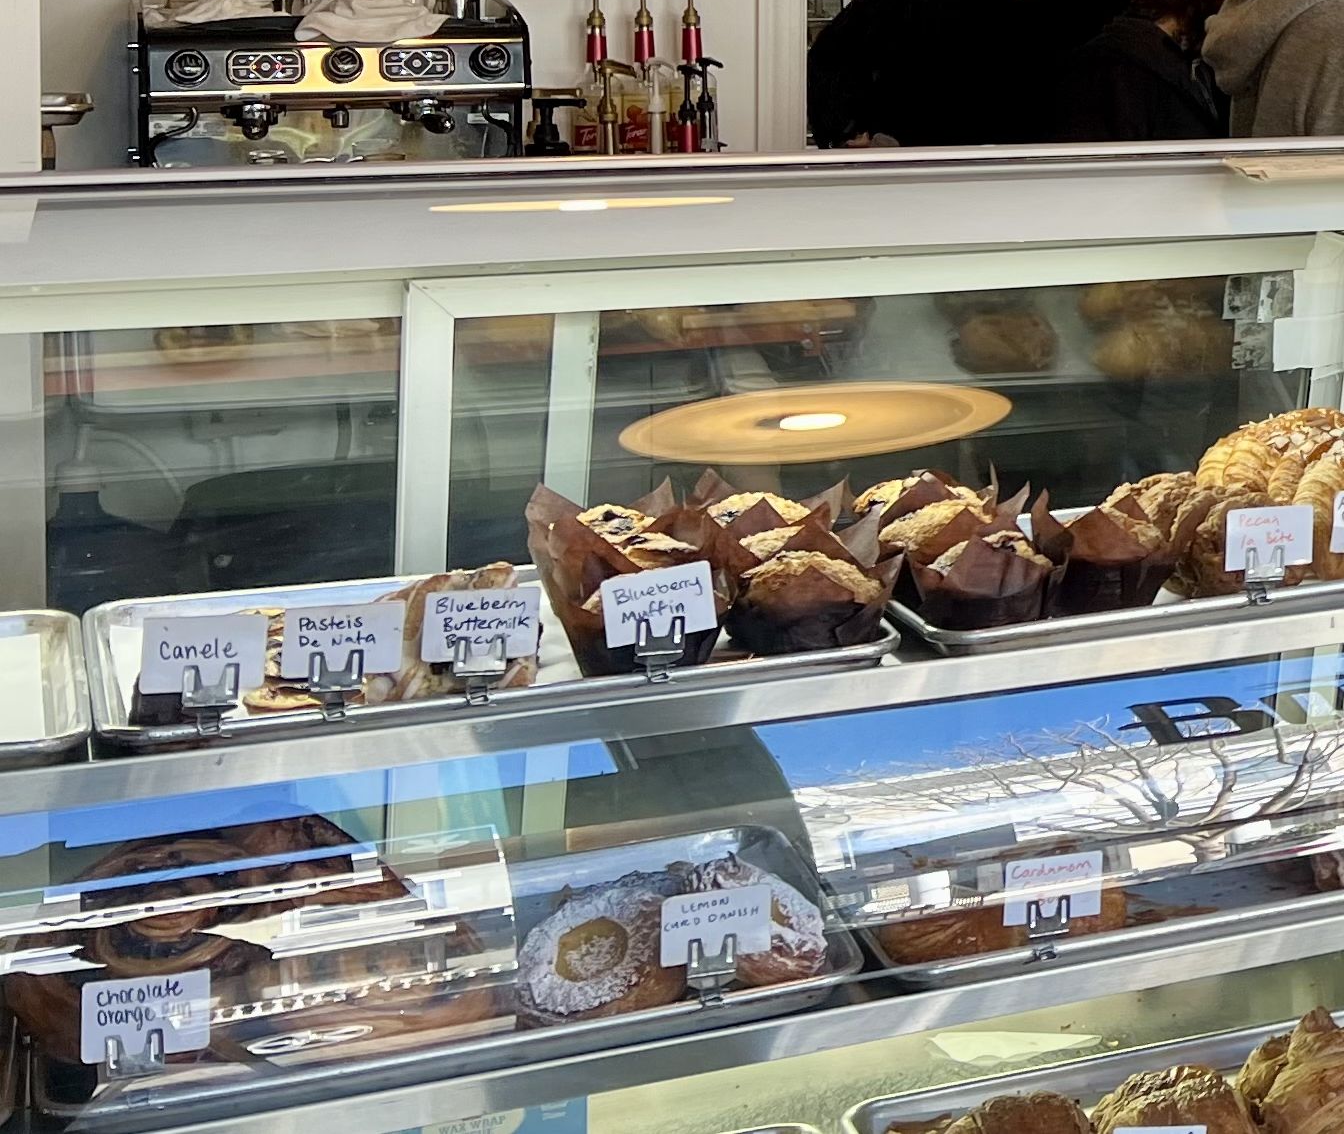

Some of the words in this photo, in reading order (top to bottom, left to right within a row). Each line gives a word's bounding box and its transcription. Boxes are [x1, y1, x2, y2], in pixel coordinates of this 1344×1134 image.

[1239, 514, 1280, 528] Pecan
[613, 577, 703, 606] Blueberry
[435, 597, 526, 615] Blueberry
[622, 601, 685, 624] Muffin
[298, 615, 364, 632] Pasteis
[443, 615, 531, 633] Buttermilk
[299, 635, 321, 648] De
[331, 630, 376, 647] Nata
[159, 638, 238, 660] Canele
[1012, 860, 1092, 879] Cardamom
[681, 896, 730, 914] LEMON
[664, 916, 701, 933] CURD
[707, 906, 759, 923] DANISH
[96, 979, 183, 1007] Chocolate
